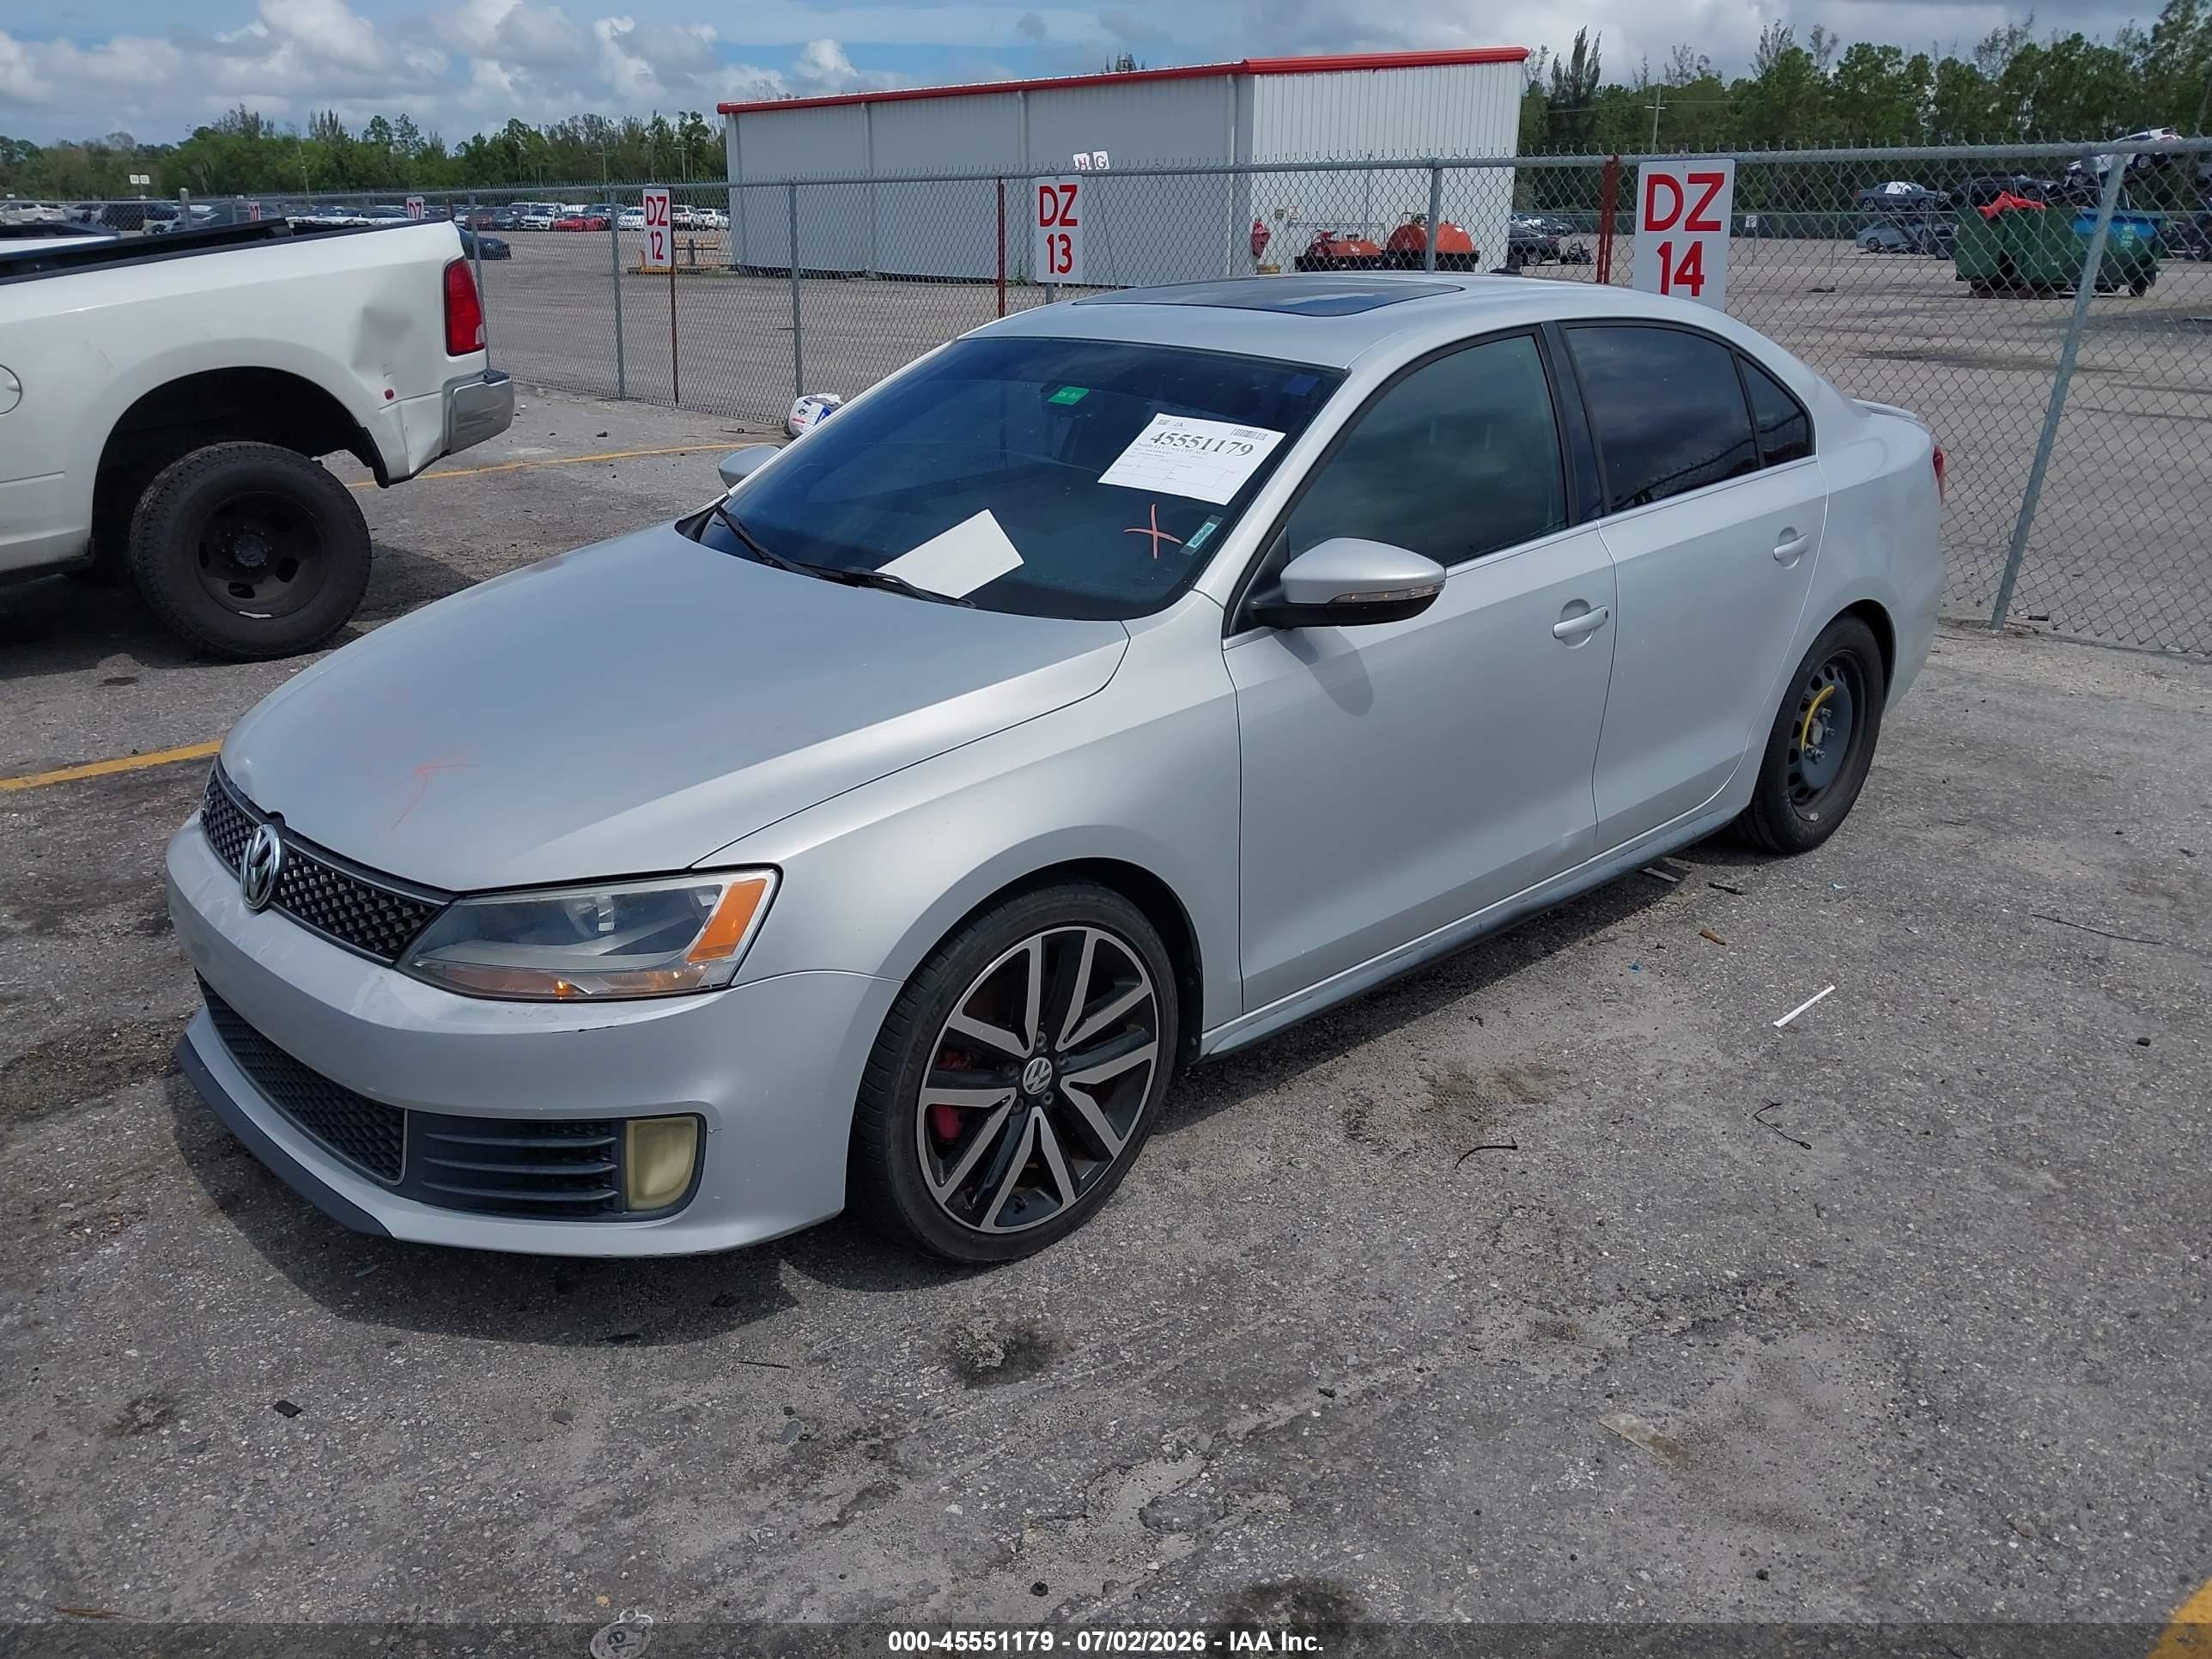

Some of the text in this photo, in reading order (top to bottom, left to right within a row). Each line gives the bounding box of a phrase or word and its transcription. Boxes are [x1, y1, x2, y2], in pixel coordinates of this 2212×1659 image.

[1096, 155, 1107, 169] G
[646, 196, 668, 226] DZ
[1039, 185, 1078, 227] DZ
[1644, 173, 1725, 232] DZ
[650, 230, 664, 260] 12
[1047, 234, 1073, 274] 13
[1656, 241, 1705, 297] 14
[1150, 431, 1255, 457] 45551179
